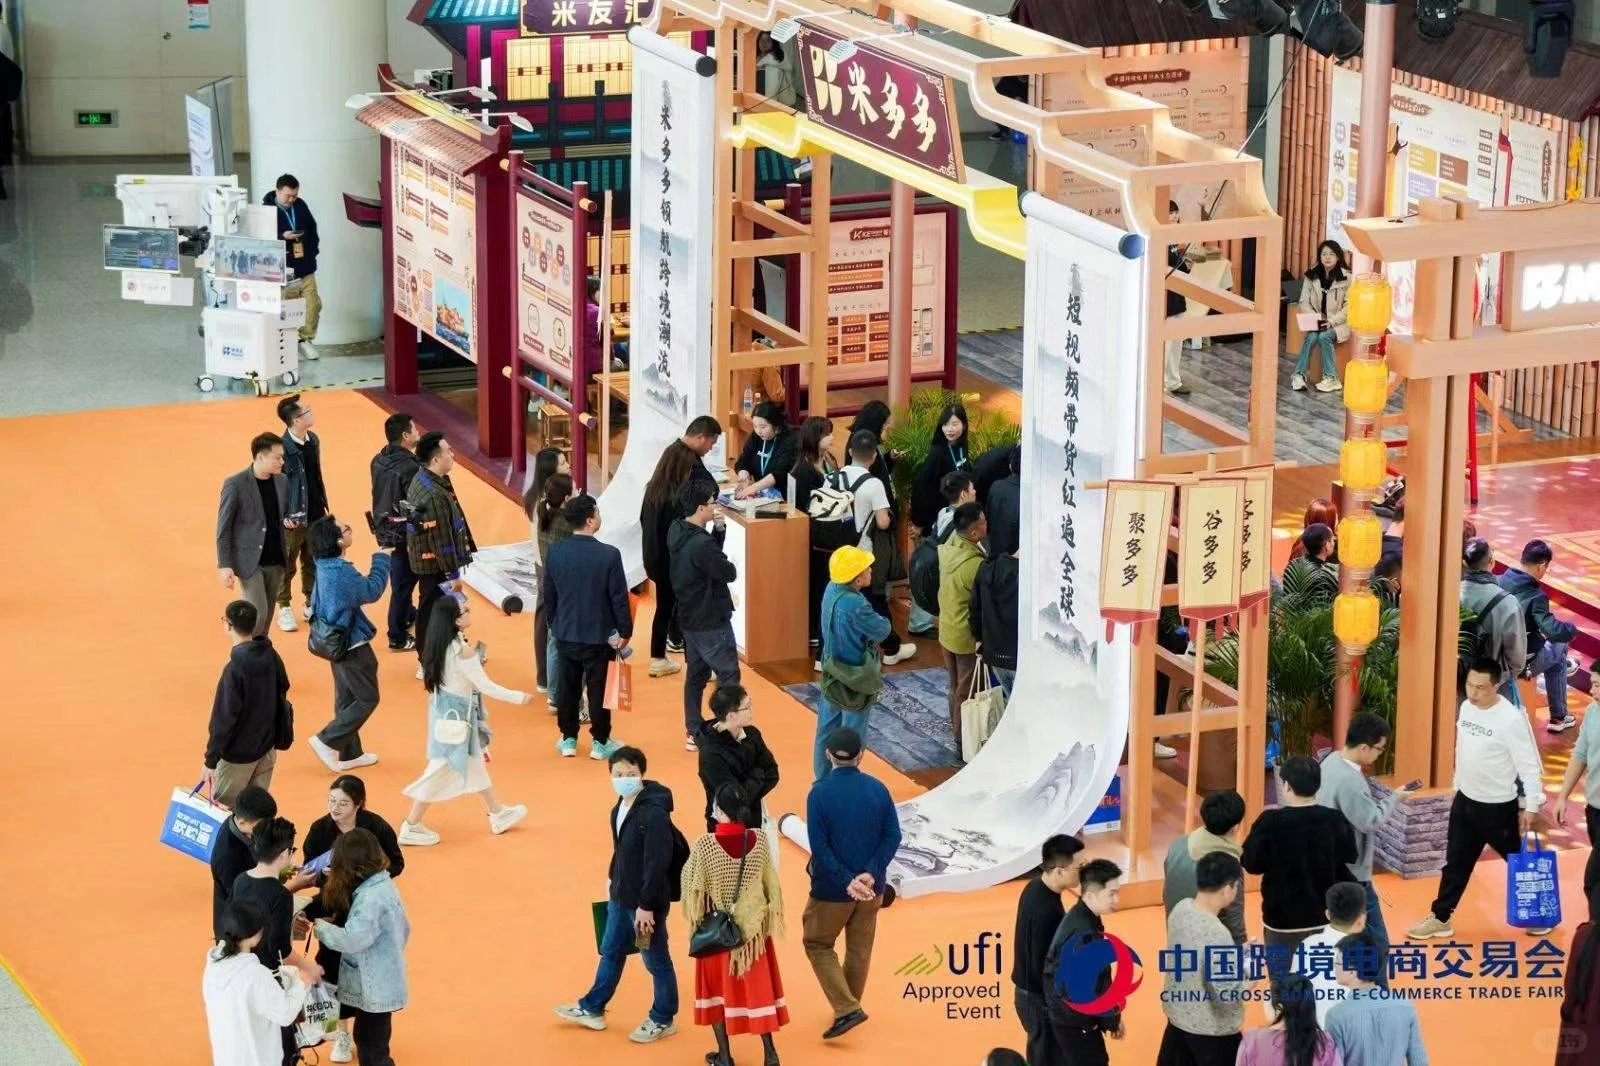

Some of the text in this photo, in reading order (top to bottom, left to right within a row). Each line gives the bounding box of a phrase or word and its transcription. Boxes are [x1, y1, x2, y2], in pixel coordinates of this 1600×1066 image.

[552, 0, 647, 26] 米友汇
[847, 61, 937, 152] 米多多
[657, 104, 673, 378] 米多多领航跨境潮流
[1060, 294, 1082, 620] 短视频带货红遍全球
[1121, 511, 1146, 587] 聚多多
[1202, 509, 1223, 585] 谷多多
